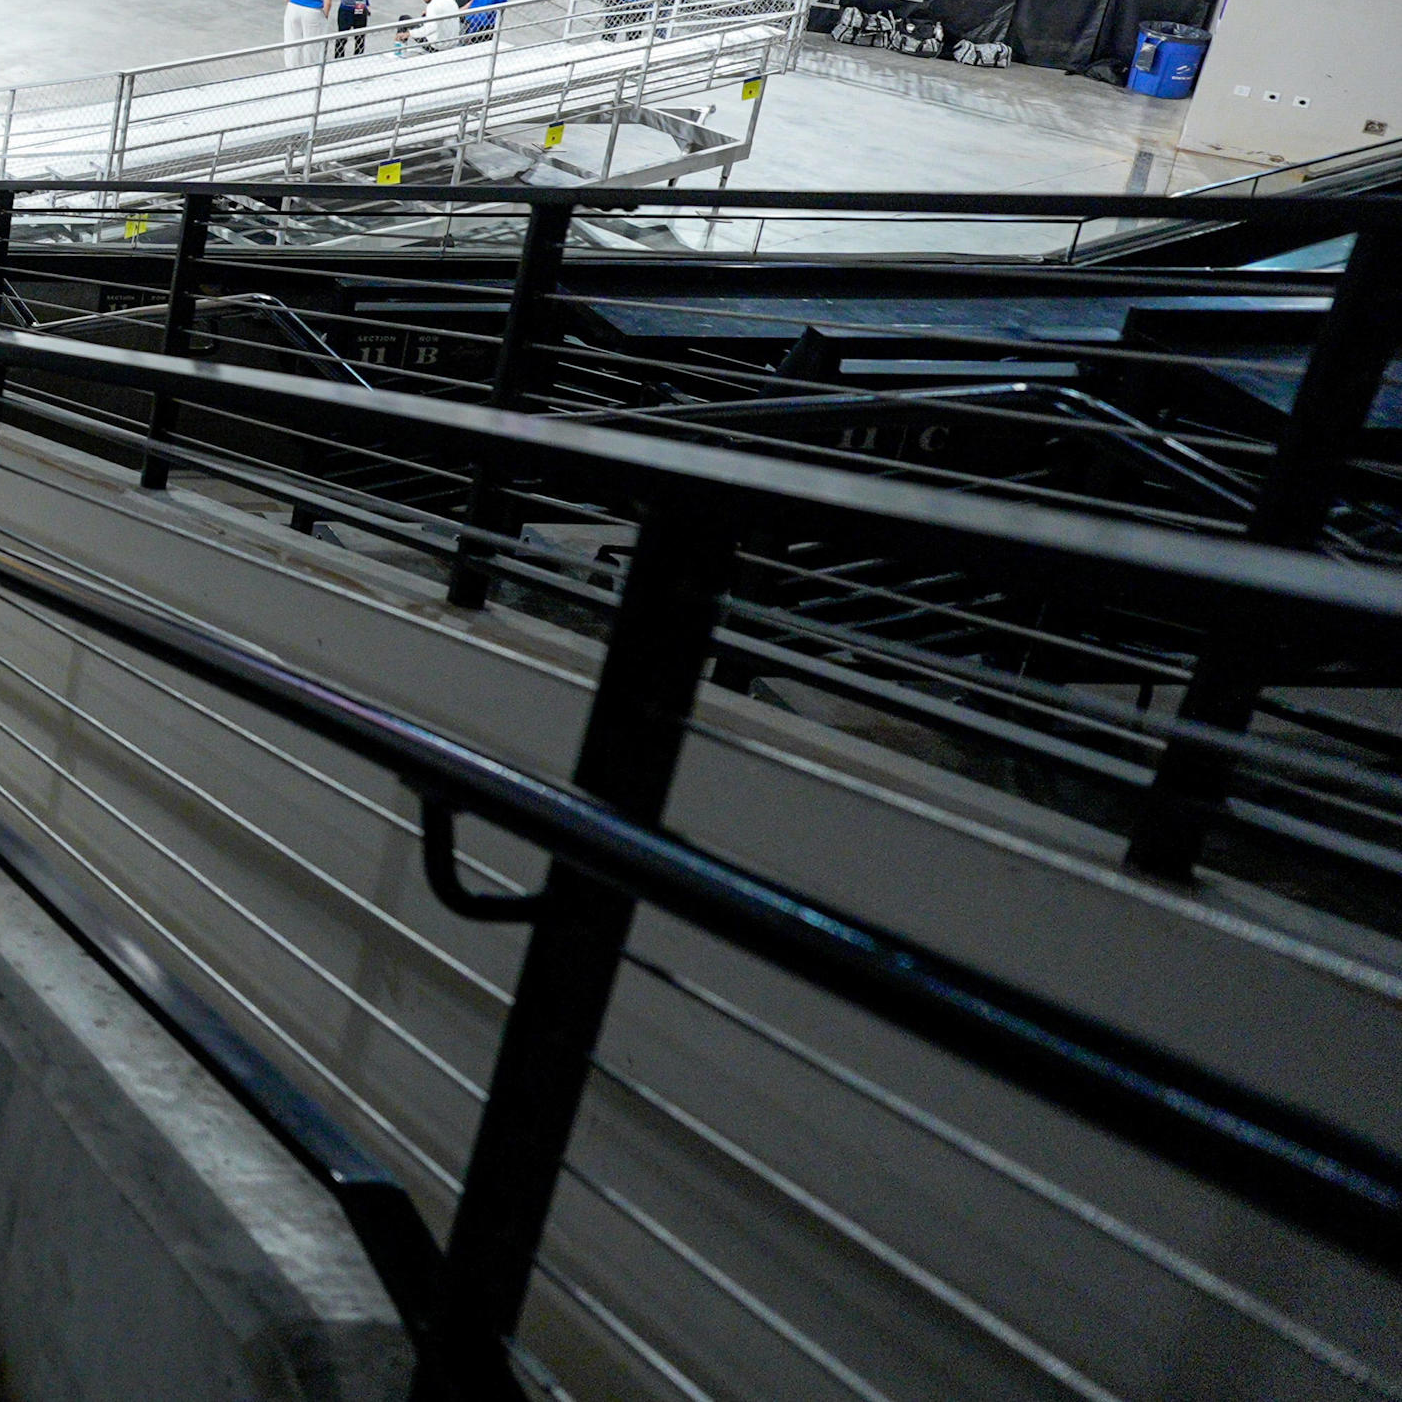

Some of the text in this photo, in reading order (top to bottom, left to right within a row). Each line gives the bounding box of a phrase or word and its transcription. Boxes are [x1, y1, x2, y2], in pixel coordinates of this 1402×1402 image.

[356, 335, 439, 343] SECTION ROW
[359, 347, 439, 365] 11 B
[837, 426, 949, 451] 11 C
